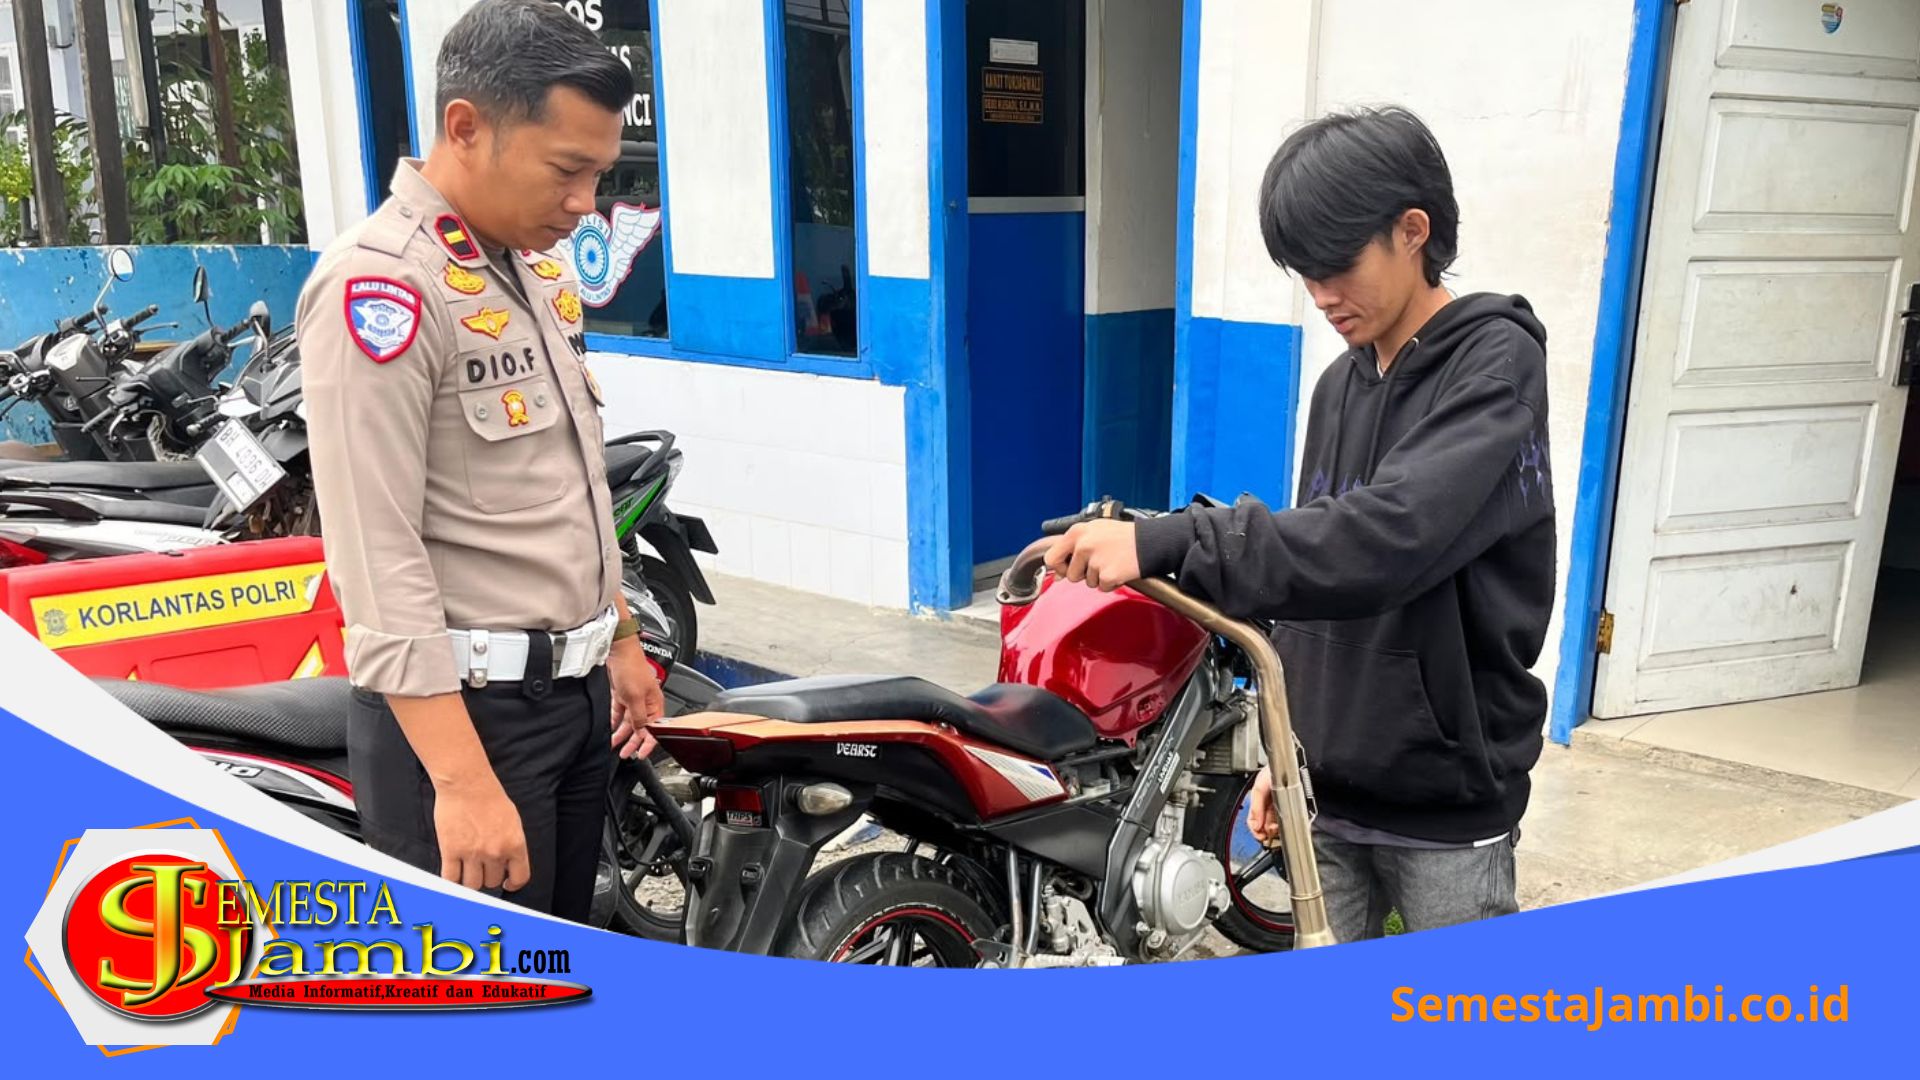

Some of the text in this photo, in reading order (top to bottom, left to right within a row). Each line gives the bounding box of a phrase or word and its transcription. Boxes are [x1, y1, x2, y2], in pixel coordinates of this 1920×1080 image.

[466, 347, 535, 383] DIO.F
[78, 580, 296, 629] KORLANTAS POLRI
[641, 641, 673, 659] HONDA
